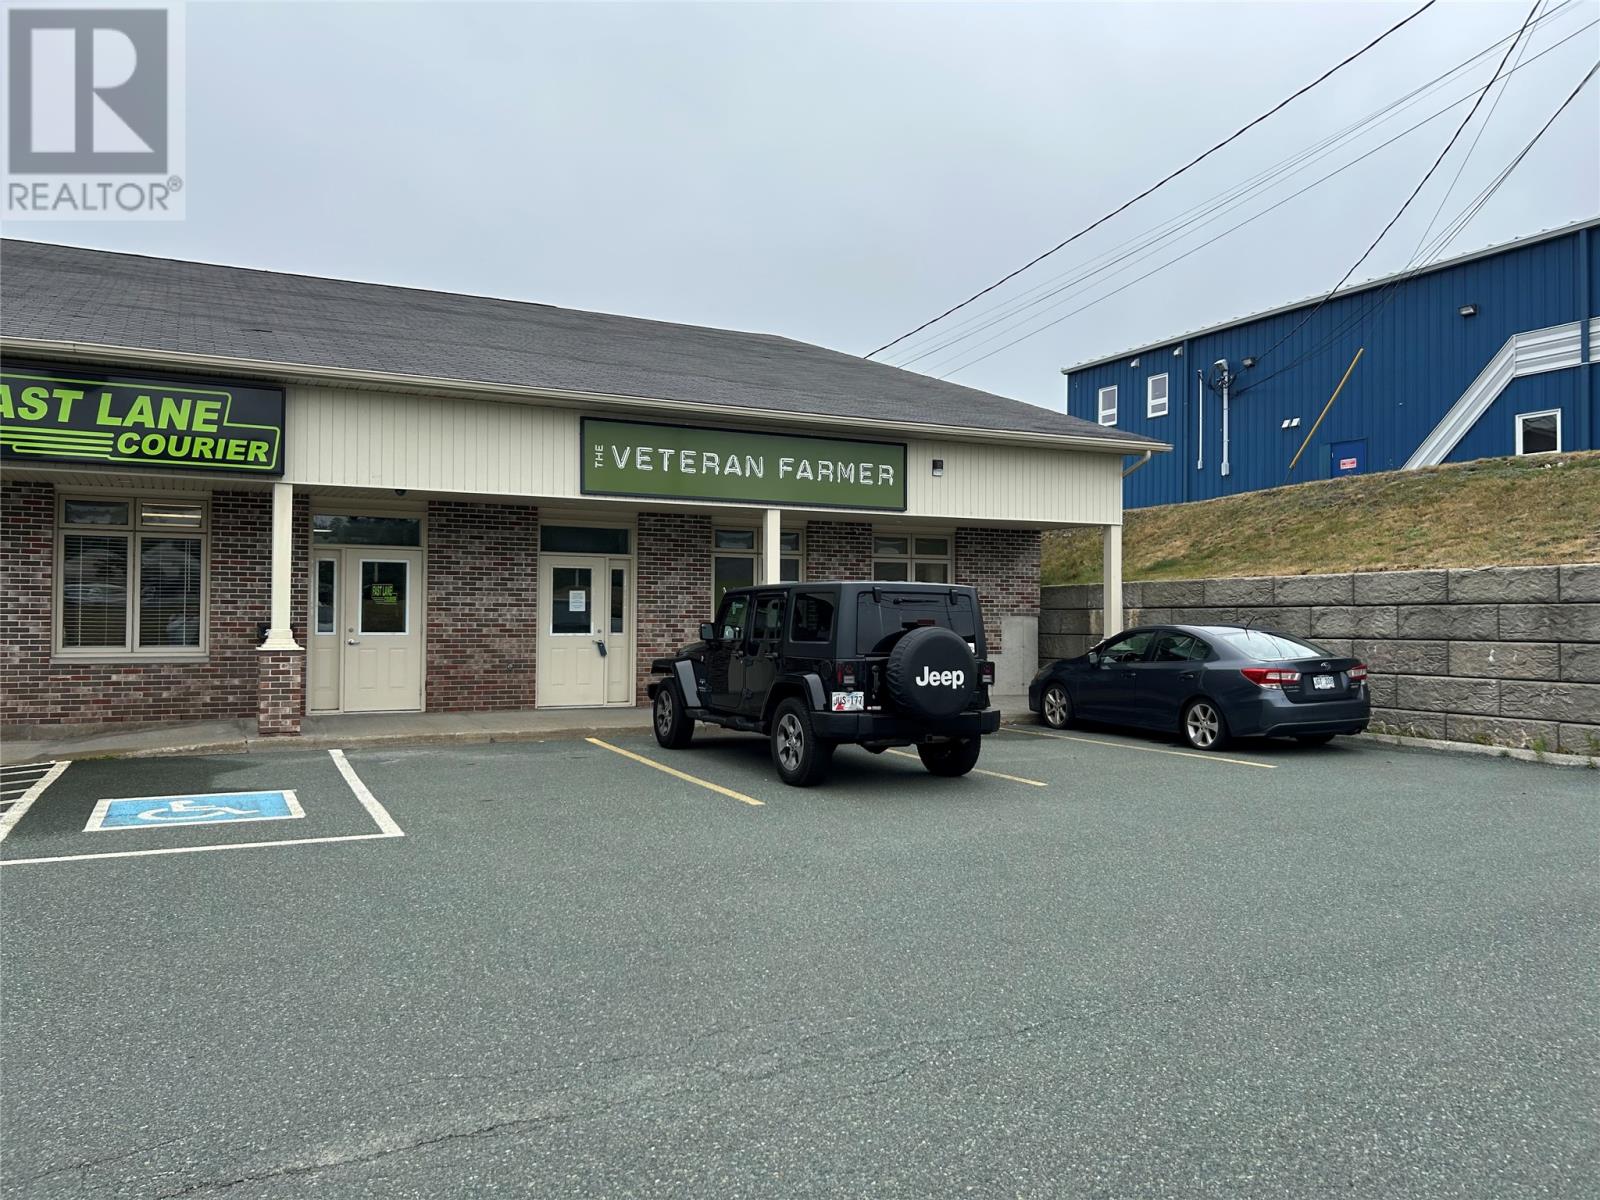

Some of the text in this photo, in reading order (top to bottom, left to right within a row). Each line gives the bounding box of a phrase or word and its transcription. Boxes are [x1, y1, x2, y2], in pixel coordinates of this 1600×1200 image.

[96, 392, 222, 433] LANE
[117, 432, 269, 463] COURIER
[594, 444, 895, 487] THE VETERAN FARMER
[915, 665, 965, 690] Jeep
